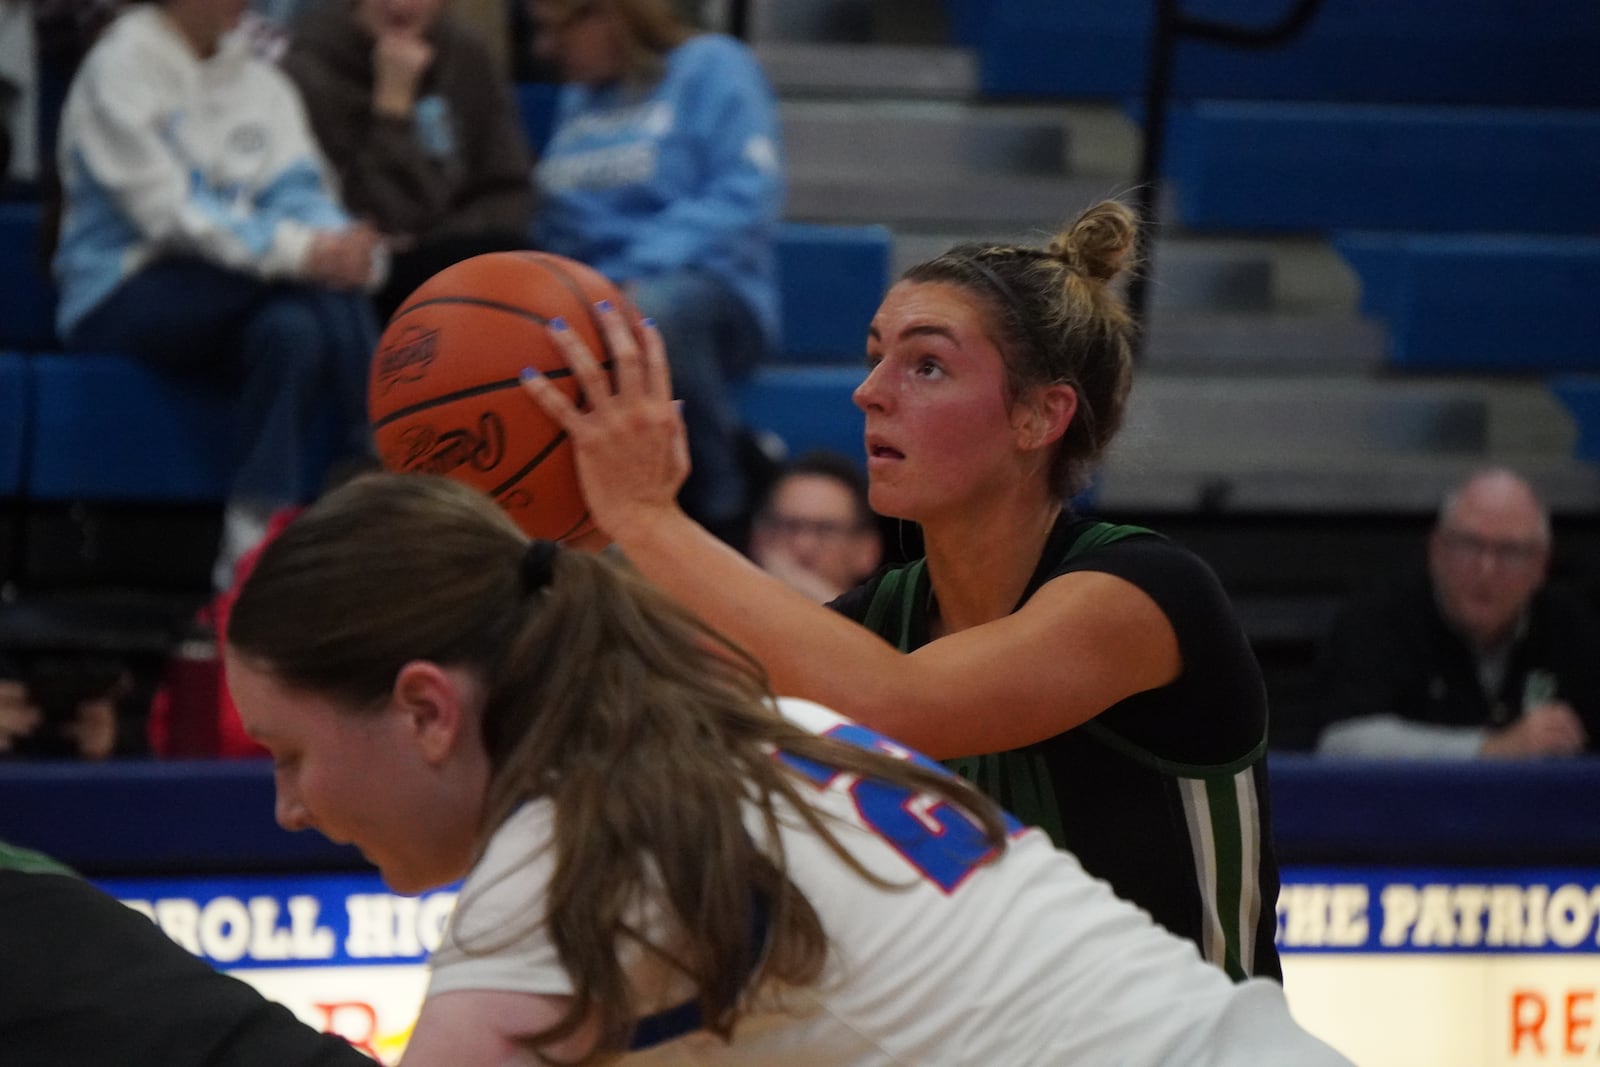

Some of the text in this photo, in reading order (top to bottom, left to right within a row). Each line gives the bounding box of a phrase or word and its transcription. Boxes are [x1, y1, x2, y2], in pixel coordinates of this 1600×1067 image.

[117, 896, 336, 962] ROLL
[1379, 883, 1600, 949] PATRIO
[1509, 989, 1600, 1056] RE
